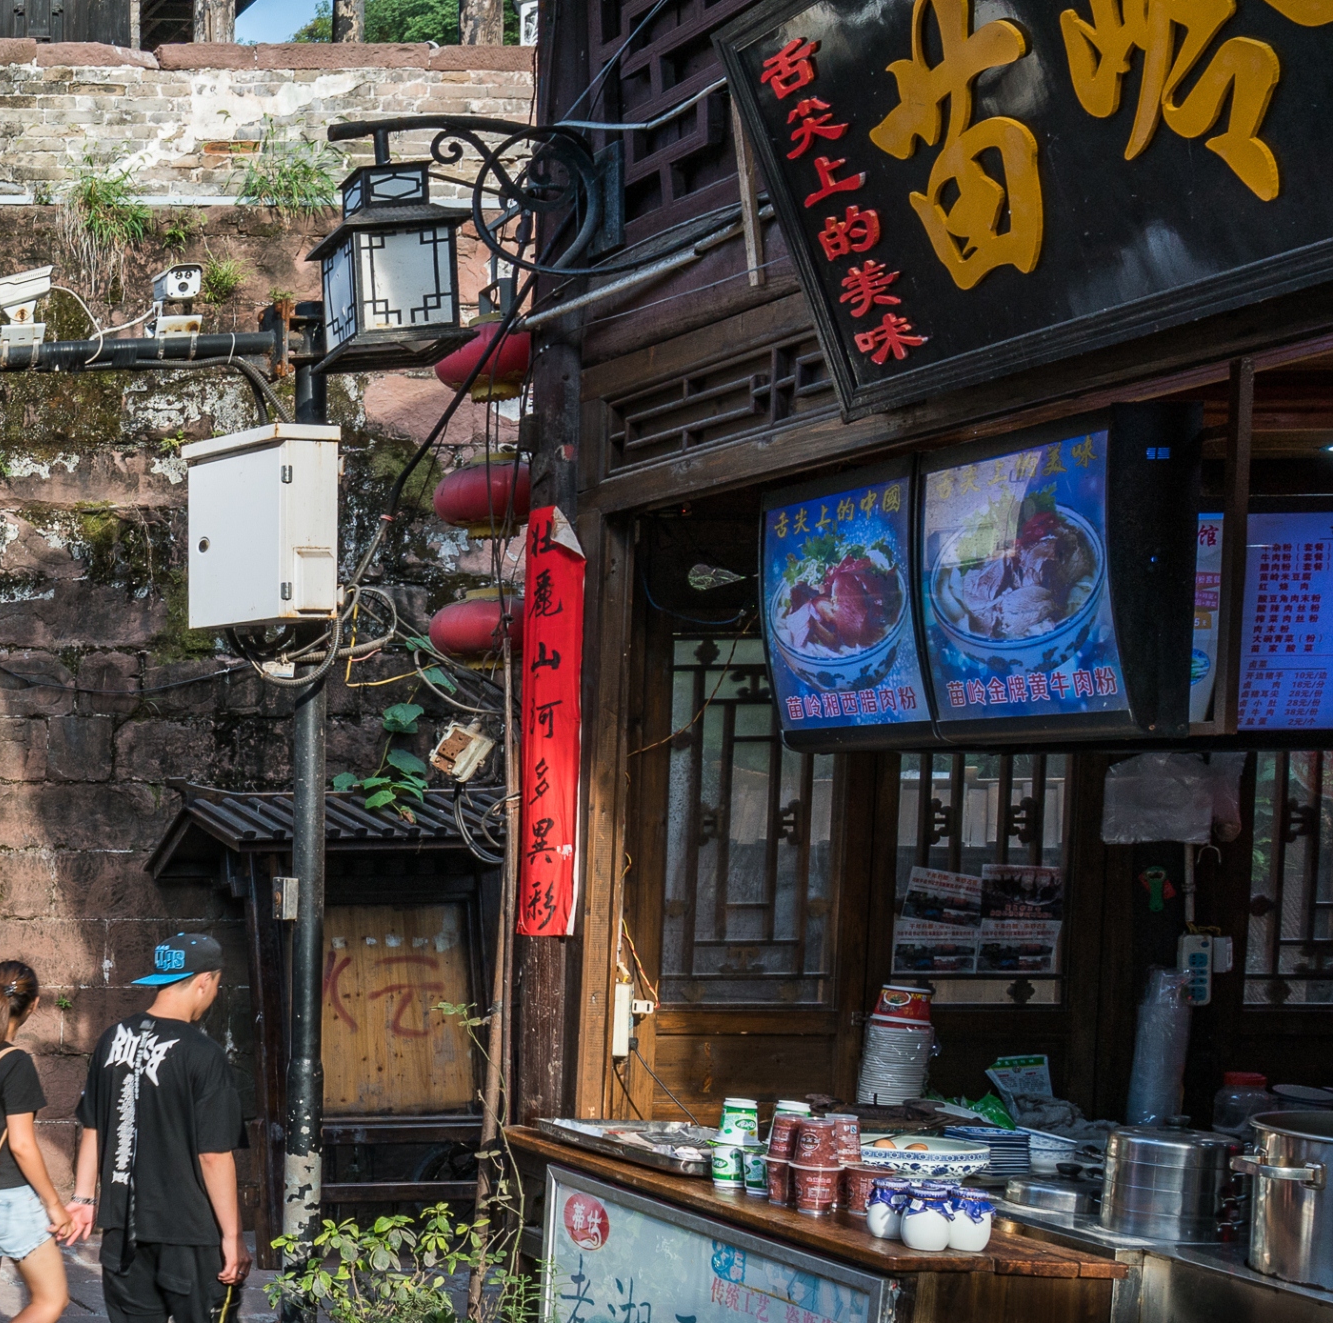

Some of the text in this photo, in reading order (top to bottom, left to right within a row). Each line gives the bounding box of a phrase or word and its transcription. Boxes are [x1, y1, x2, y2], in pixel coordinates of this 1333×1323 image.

[760, 37, 928, 365] 舌尖上的美味
[935, 434, 1097, 499] 舌尖上的美味
[774, 484, 901, 538] 舌尖上的中國
[1198, 525, 1219, 547] 馆
[785, 686, 917, 720] 苗岭湘西腊肉粉
[946, 666, 1119, 708] 苗岭金牌黄牛肉粉
[710, 1276, 771, 1323] 传统工艺
